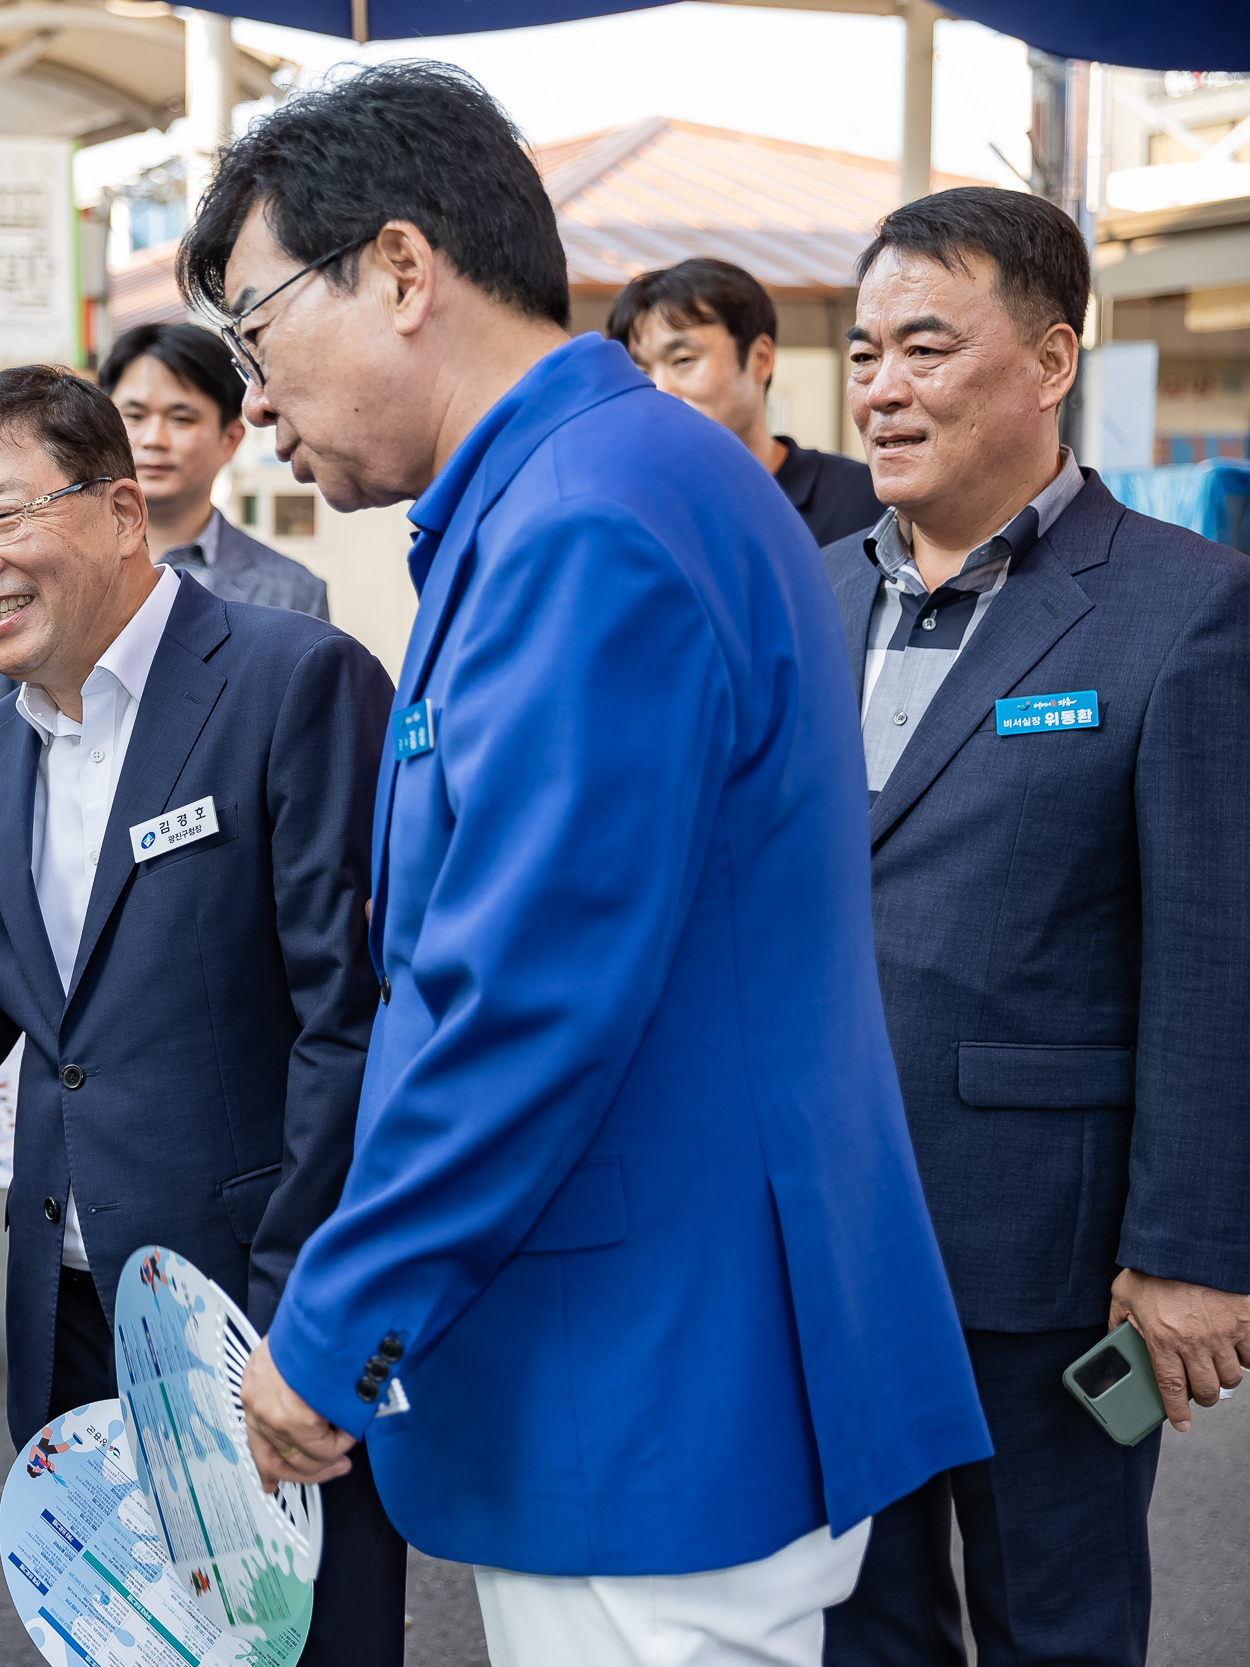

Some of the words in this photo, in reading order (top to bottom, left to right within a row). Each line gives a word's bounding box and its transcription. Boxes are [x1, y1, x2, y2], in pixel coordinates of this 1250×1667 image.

[1003, 716, 1041, 728] 비서실장
[1044, 708, 1093, 726] 위동환
[167, 824, 202, 844] 광진구청장
[84, 1422, 110, 1448] 장흥군
[50, 1517, 68, 1535] 프로그램
[63, 1531, 75, 1543] 기타
[17, 1562, 35, 1579] 프로그램
[125, 1593, 143, 1610] 프로그램
